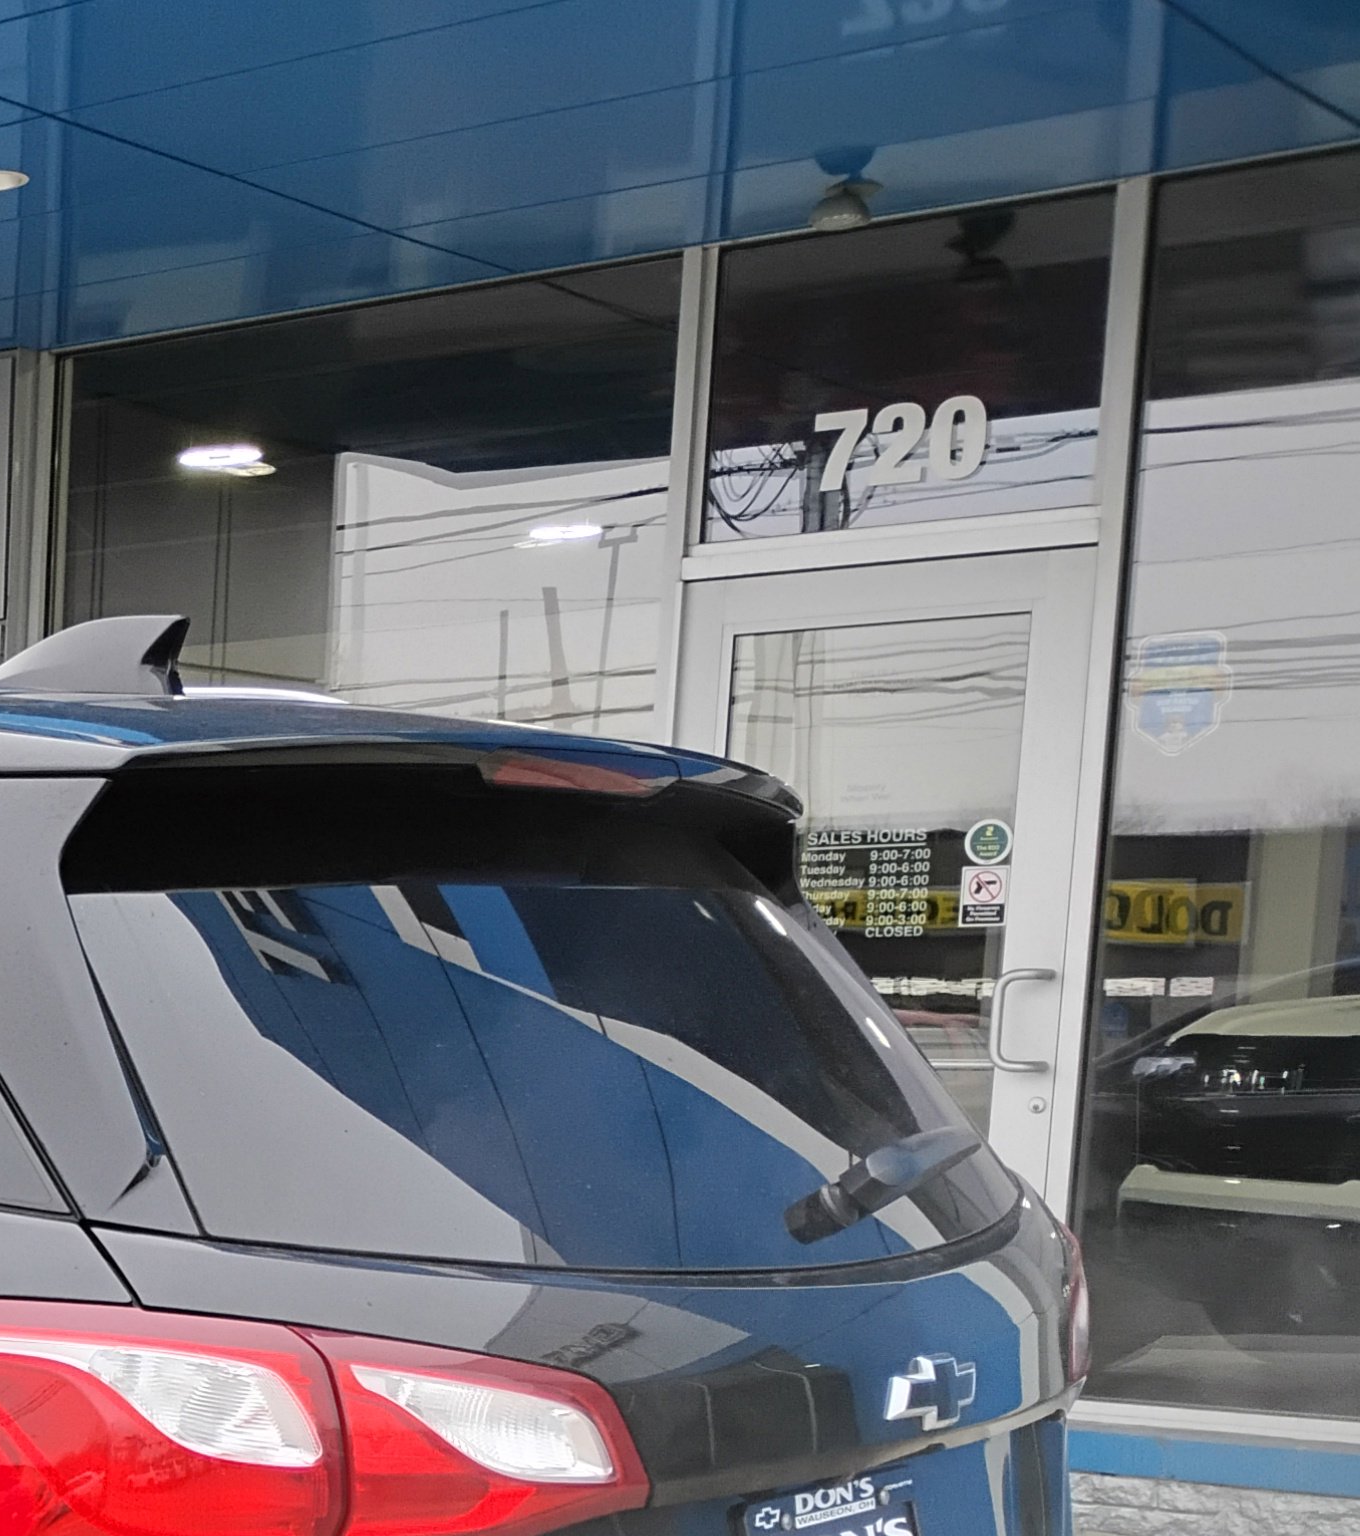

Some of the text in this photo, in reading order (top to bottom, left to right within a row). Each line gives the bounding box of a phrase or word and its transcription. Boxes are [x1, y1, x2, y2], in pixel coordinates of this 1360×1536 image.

[814, 395, 987, 492] 720
[808, 828, 927, 846] SALES HOURS
[801, 848, 931, 863] Monday 9:00-7:00
[801, 862, 930, 876] Tuesday 9:00-6:00
[799, 875, 929, 889] Wednesday 9:00-6:00
[867, 888, 928, 900] 9:00-7:00
[867, 902, 927, 914] 9:00-6:00
[865, 915, 927, 927] 9:00-3:00
[865, 927, 923, 938] CLOSED
[795, 1477, 875, 1515] DON'S
[797, 1500, 875, 1526] WAUSEON, OH
